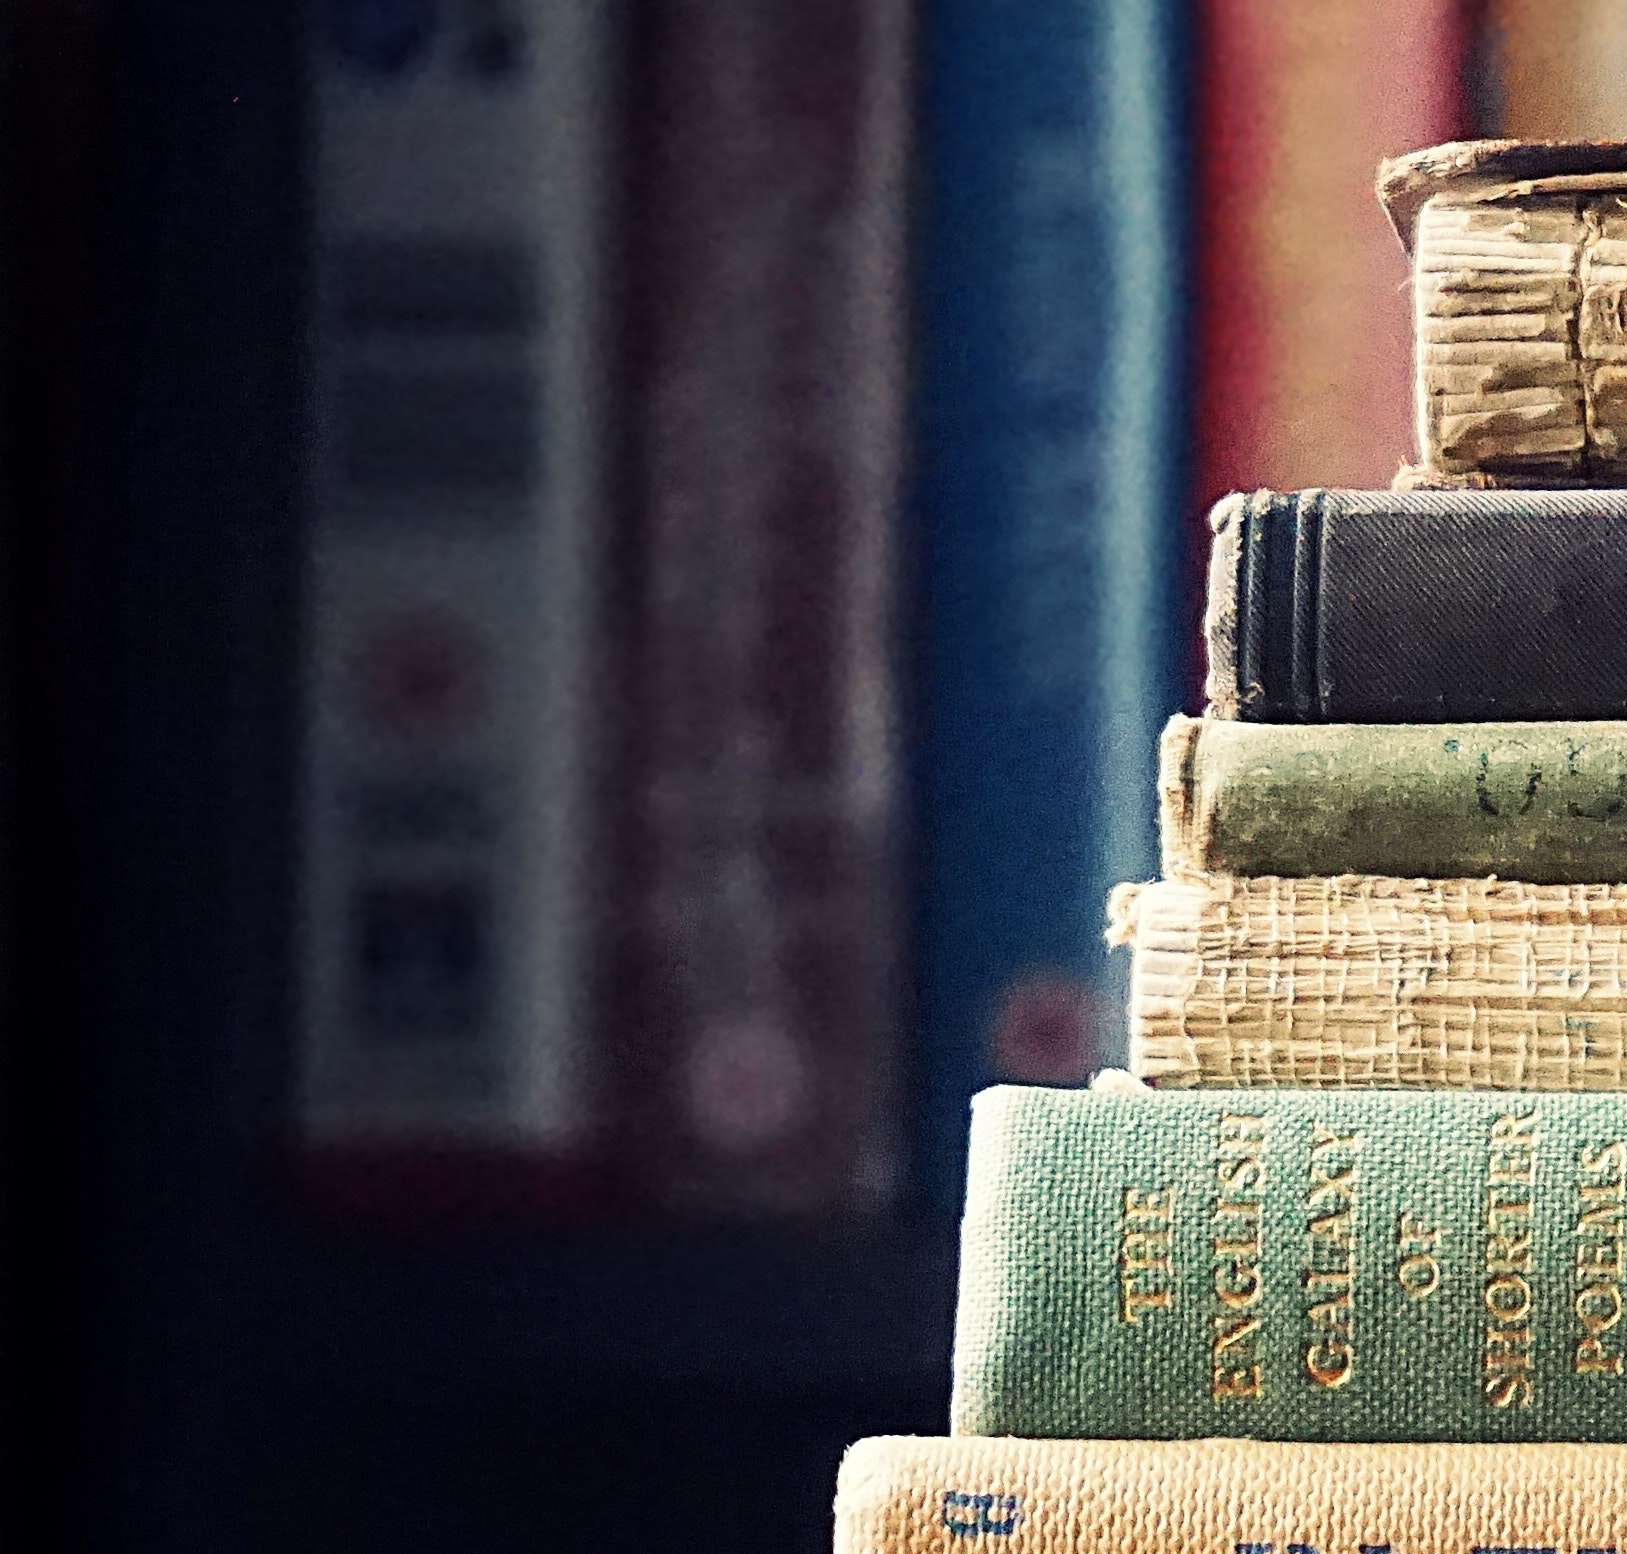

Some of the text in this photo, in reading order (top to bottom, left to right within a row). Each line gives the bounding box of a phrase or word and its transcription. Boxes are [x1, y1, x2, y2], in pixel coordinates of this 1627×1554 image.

[1119, 1184, 1173, 1323] THE
[1211, 1109, 1266, 1404] ENGLISH
[1306, 1122, 1363, 1390] GALAXY
[1397, 1209, 1443, 1298] OF
[1485, 1106, 1541, 1409] SHORTER
[1574, 1139, 1627, 1377] POEMS
